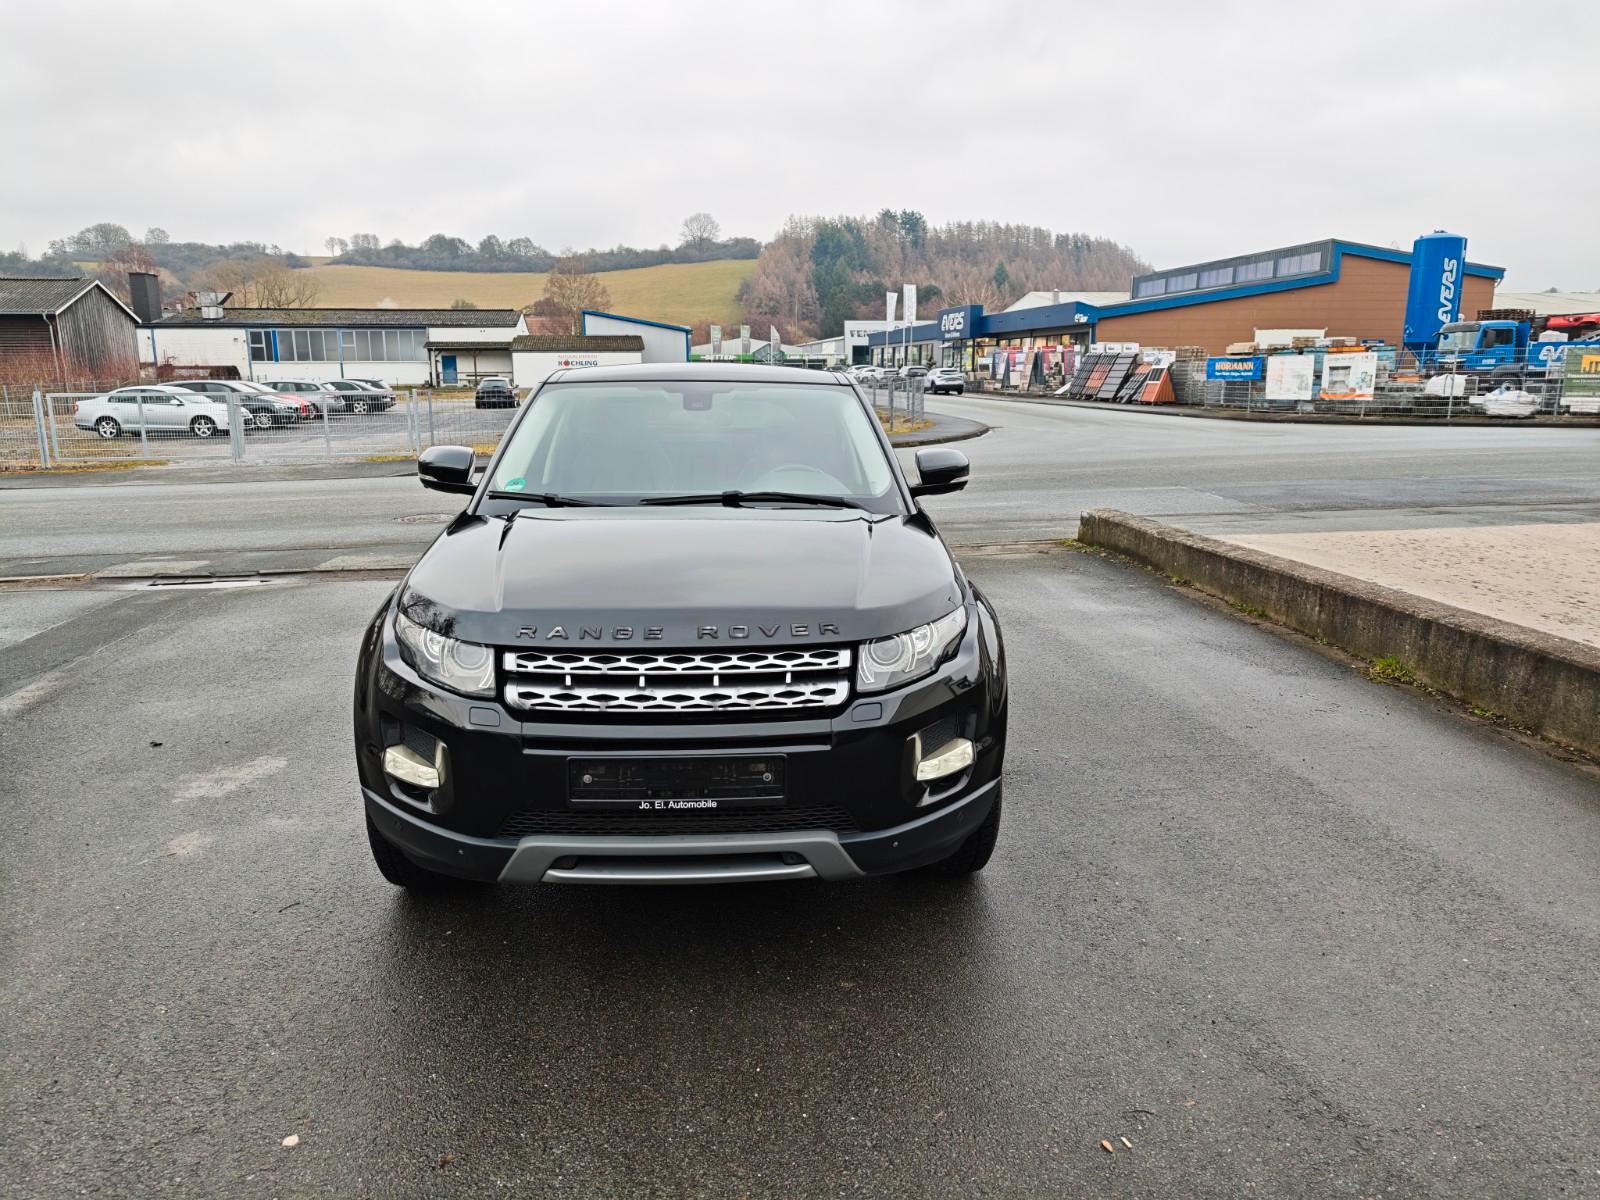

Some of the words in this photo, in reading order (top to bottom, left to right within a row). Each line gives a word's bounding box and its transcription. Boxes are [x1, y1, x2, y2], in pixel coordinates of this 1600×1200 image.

[515, 624, 663, 641] RANGE
[697, 623, 840, 640] ROVER
[639, 801, 652, 810] Jo.
[668, 799, 717, 809] Automobile
